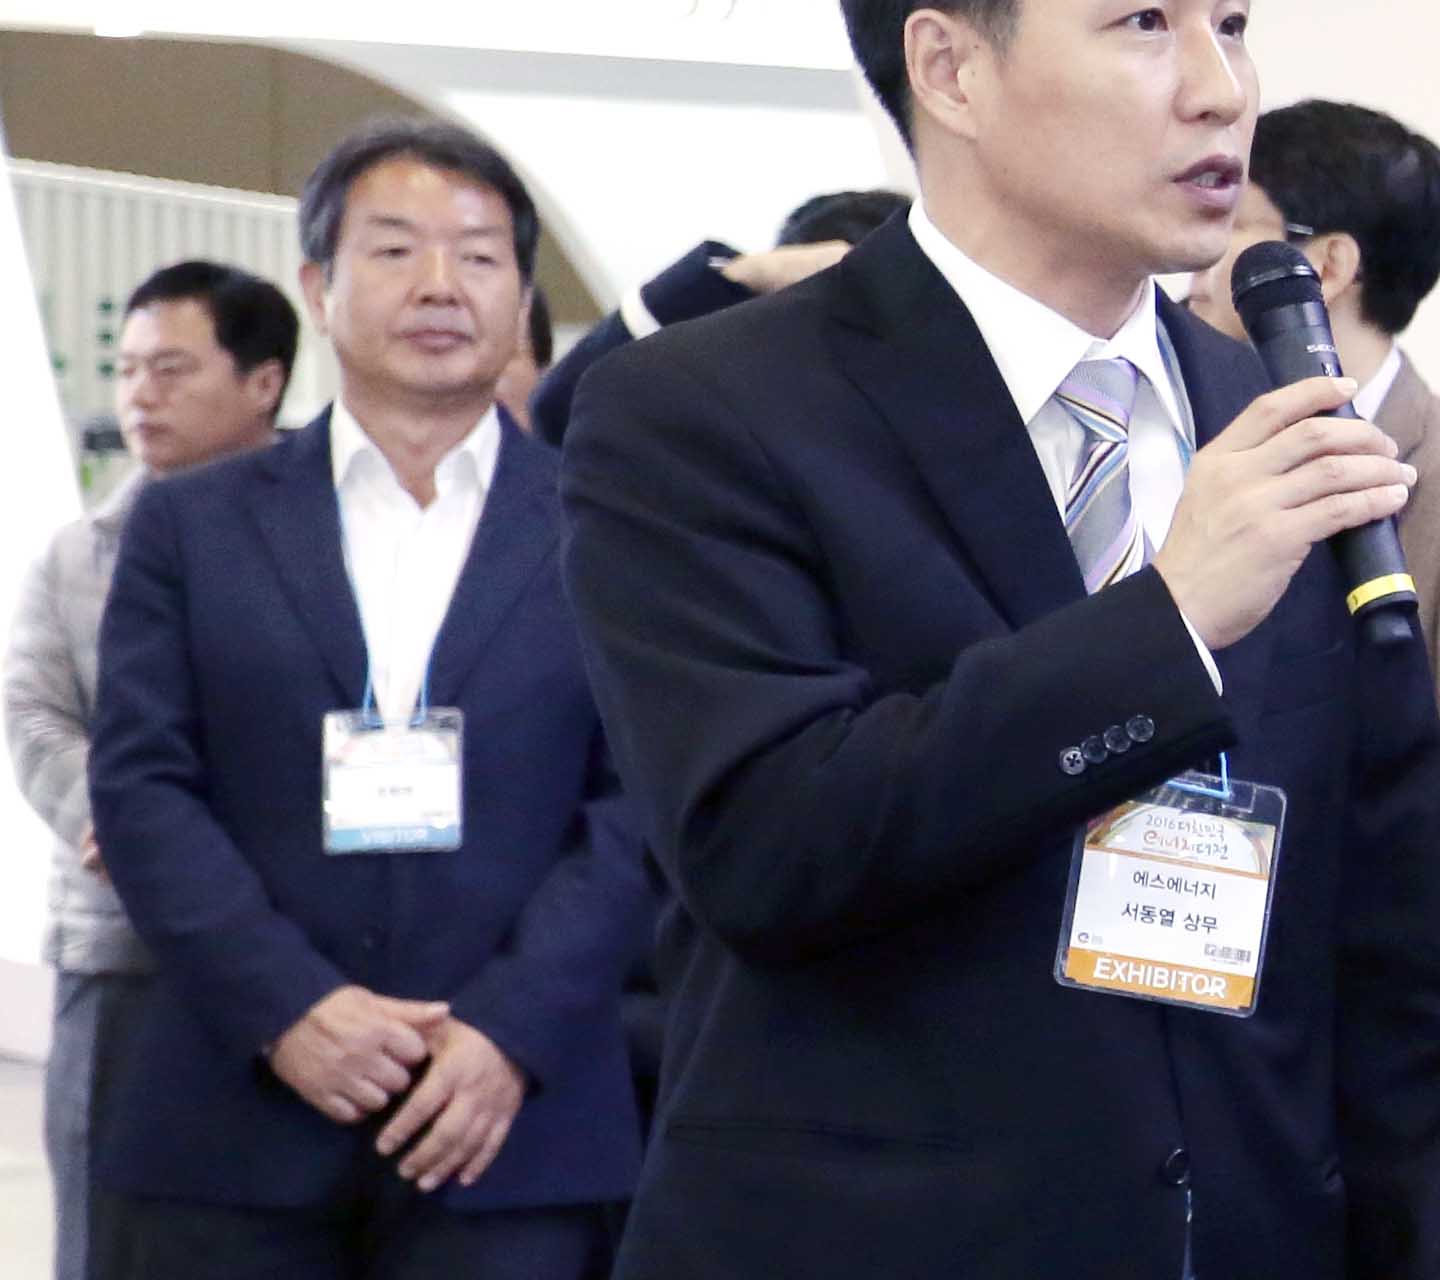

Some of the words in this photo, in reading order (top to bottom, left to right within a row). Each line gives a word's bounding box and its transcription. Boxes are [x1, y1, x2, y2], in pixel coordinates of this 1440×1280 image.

[1132, 870, 1217, 900] 에스에너지
[1121, 901, 1175, 928] 서동열
[1183, 911, 1219, 934] 상무
[1093, 957, 1227, 999] EXHIBITOR
